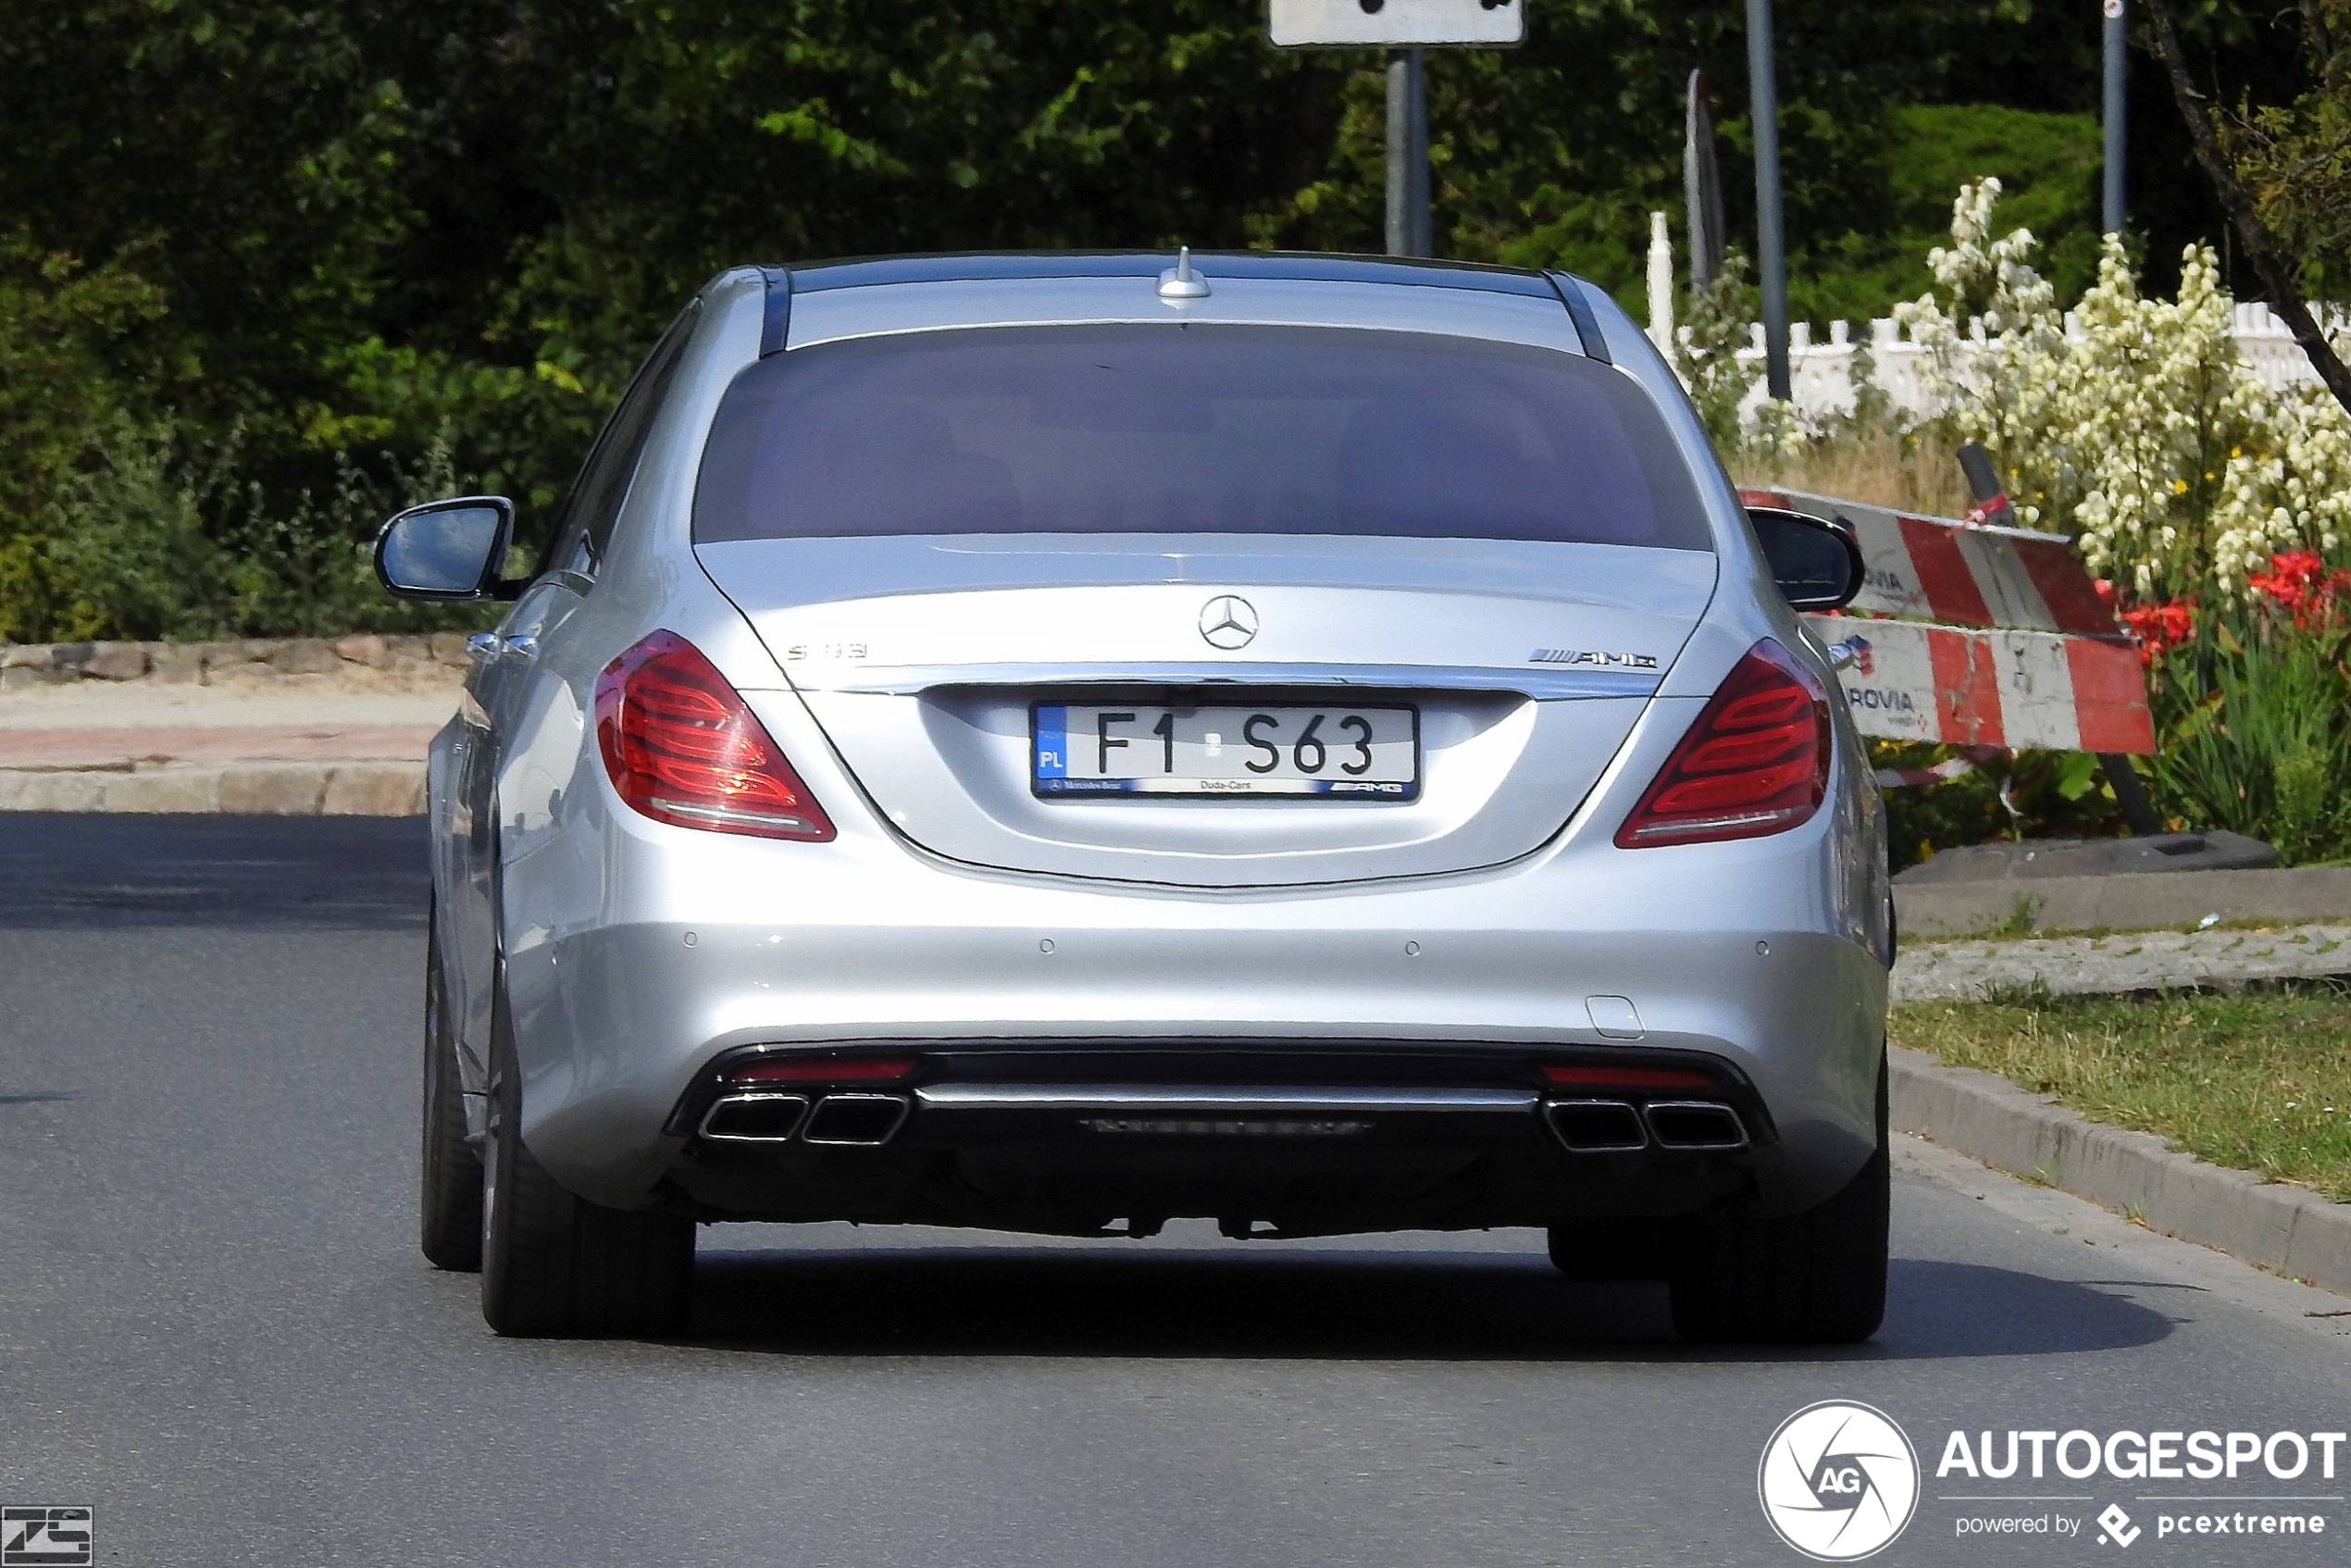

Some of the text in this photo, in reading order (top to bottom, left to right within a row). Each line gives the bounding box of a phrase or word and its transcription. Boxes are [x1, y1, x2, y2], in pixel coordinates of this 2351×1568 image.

[1039, 751, 1064, 768] PL
[1098, 713, 1373, 776] F1 S63
